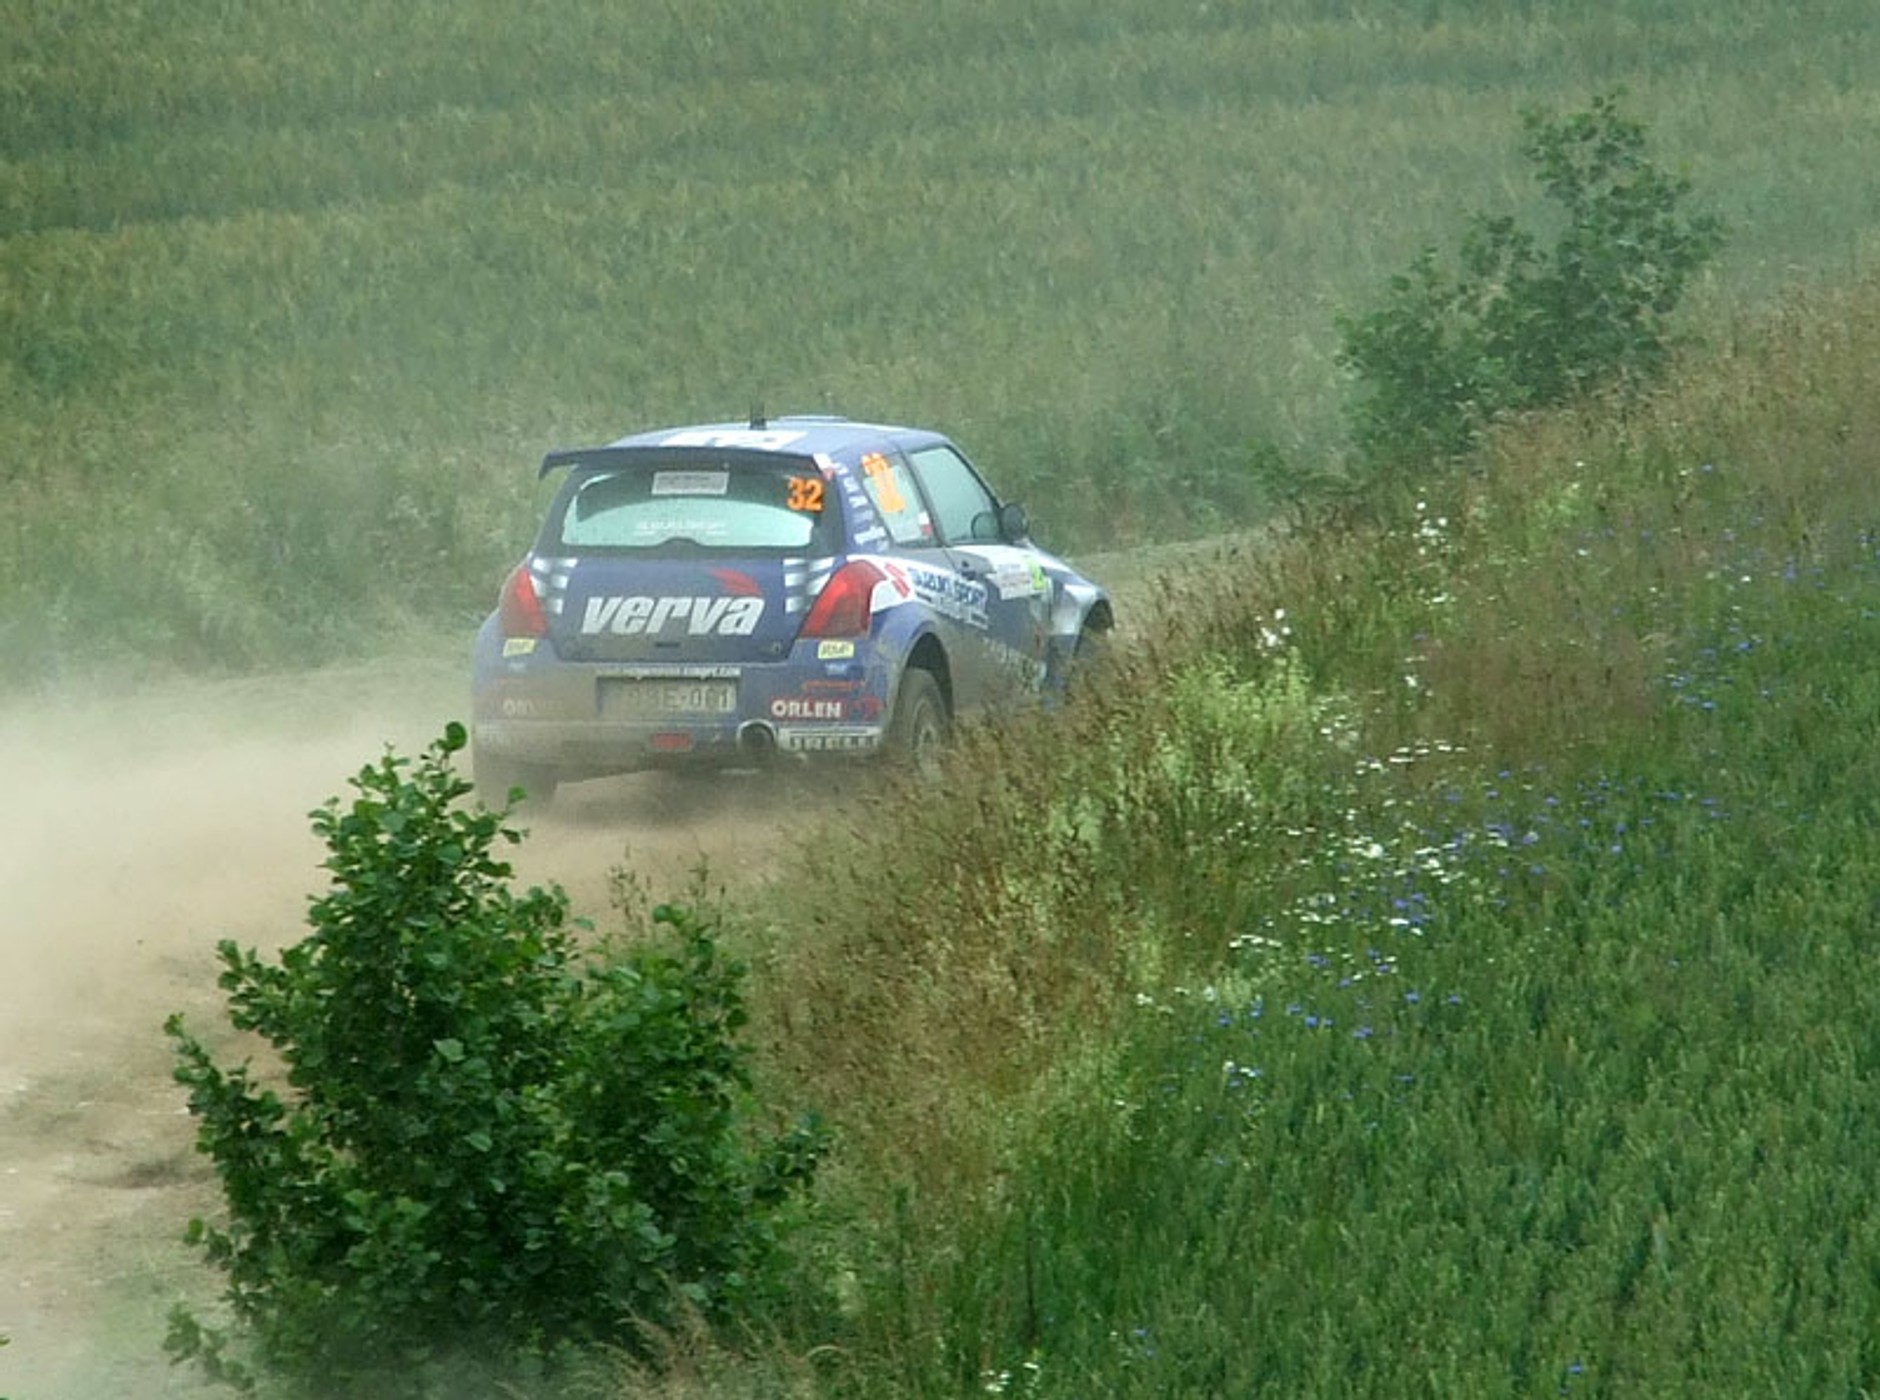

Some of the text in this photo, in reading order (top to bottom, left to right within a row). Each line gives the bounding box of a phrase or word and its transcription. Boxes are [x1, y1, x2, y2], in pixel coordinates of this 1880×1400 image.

[786, 474, 823, 512] 32
[581, 596, 765, 635] verva
[771, 700, 842, 718] ORLEN
